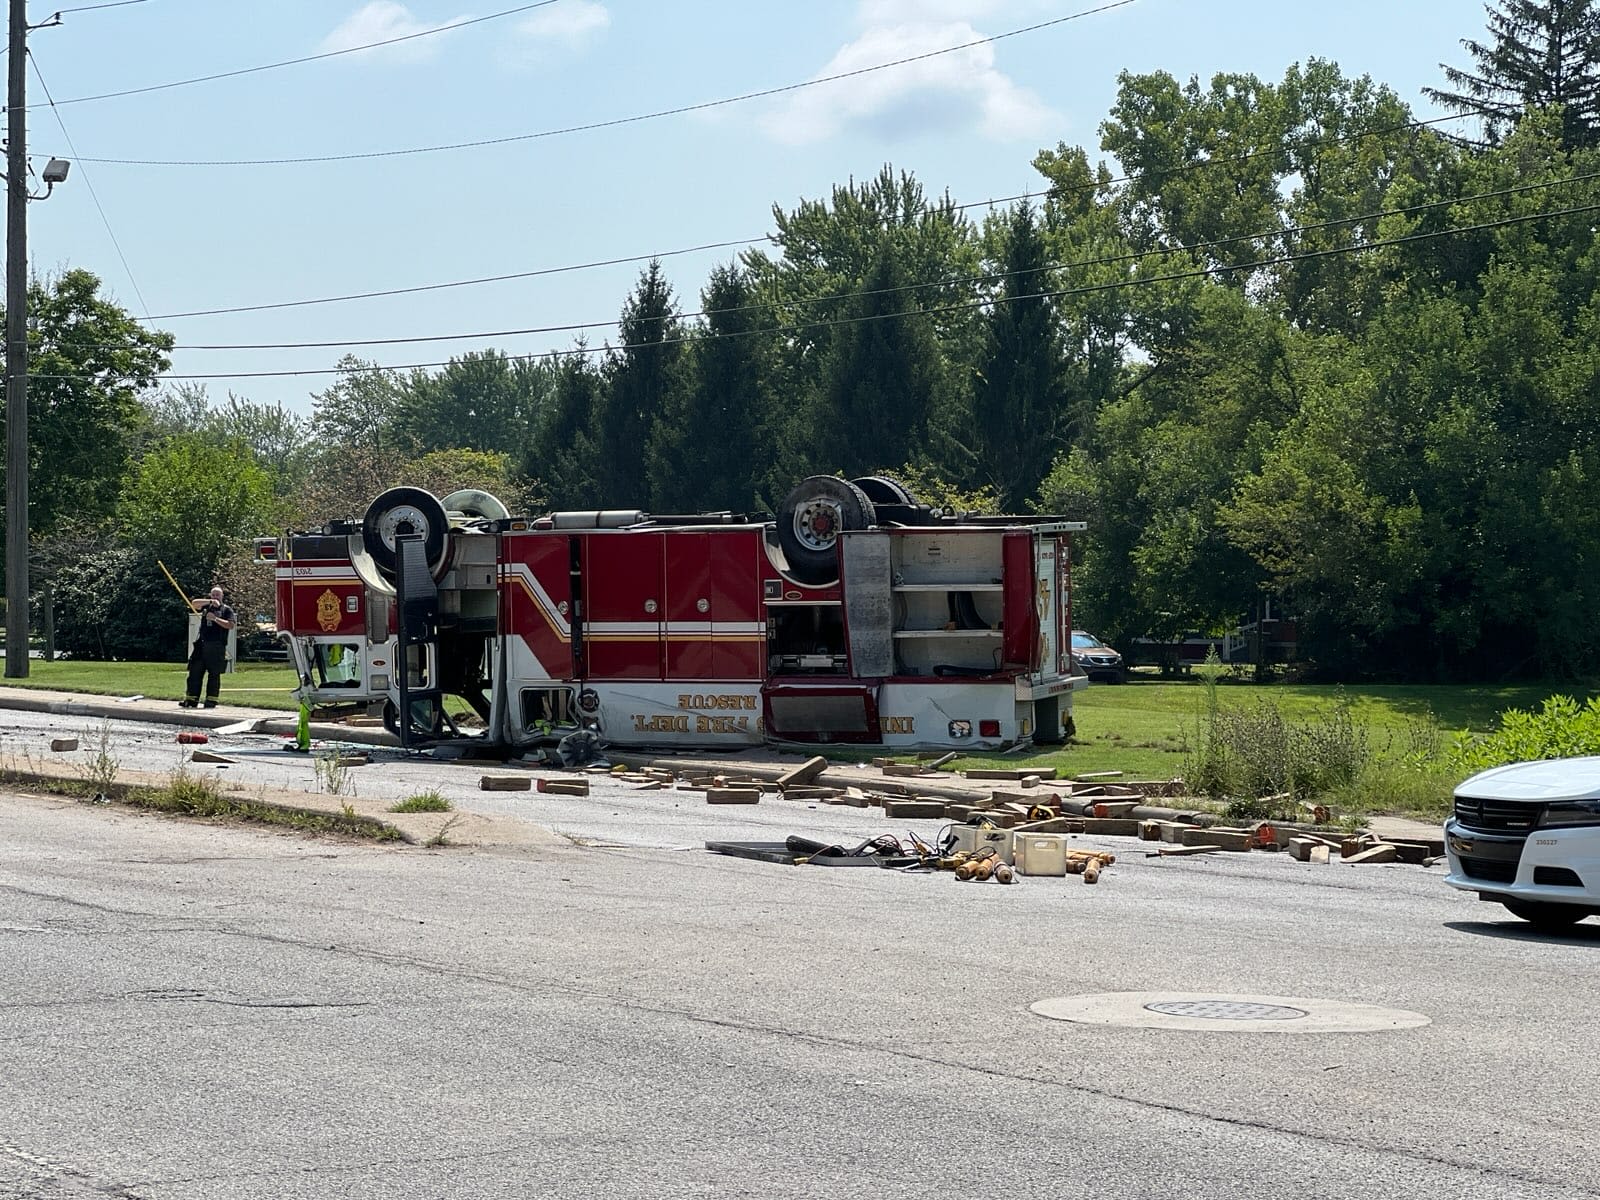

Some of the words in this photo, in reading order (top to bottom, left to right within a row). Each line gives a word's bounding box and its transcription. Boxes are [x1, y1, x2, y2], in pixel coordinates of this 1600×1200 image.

[678, 694, 757, 710] RESCUE
[631, 714, 689, 732] DEPT.
[697, 716, 749, 734] FIRE
